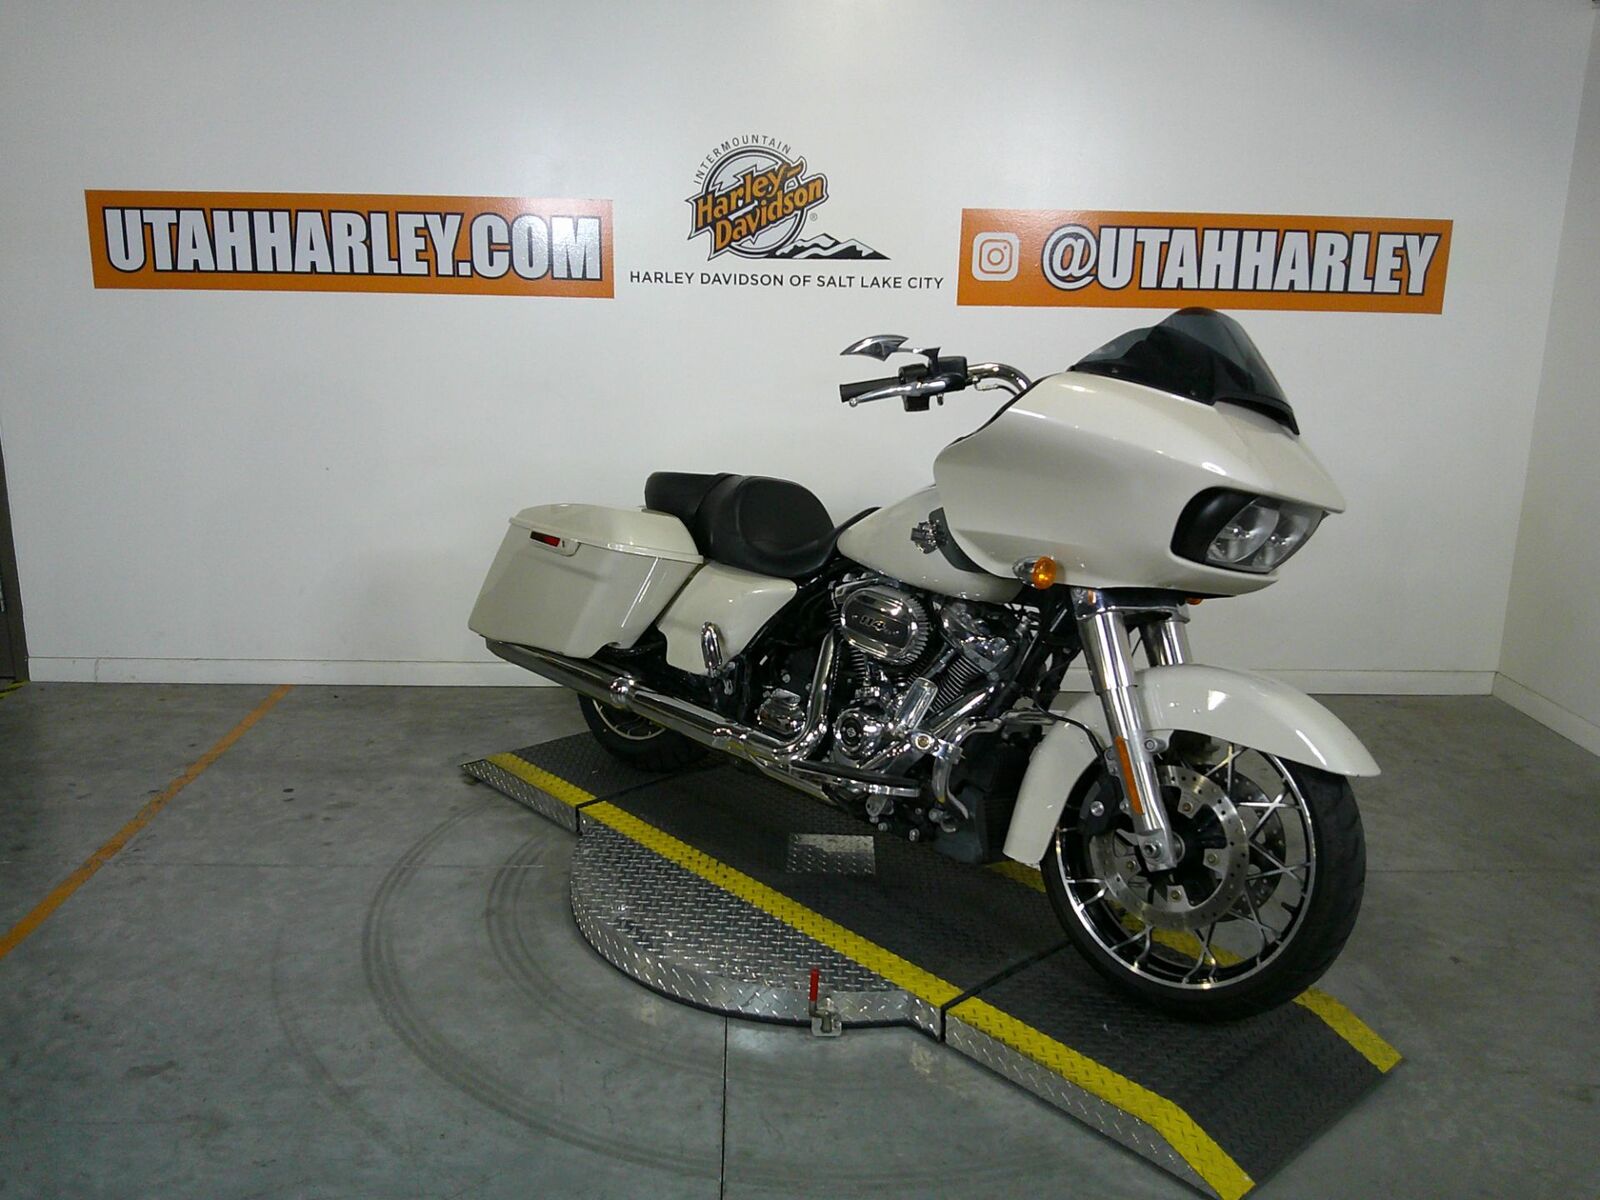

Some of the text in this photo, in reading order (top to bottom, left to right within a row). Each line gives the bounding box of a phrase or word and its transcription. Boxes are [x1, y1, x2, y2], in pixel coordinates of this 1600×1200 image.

[694, 134, 791, 185] INTERMOUNTAIN
[102, 207, 602, 281] UTAHHARLEY.COM
[714, 178, 824, 251] Davidson
[630, 271, 944, 289] HARLEY DAVIDSON OF SALT LAKE CITY
[1042, 224, 1441, 294] @UTAHHARLEY
